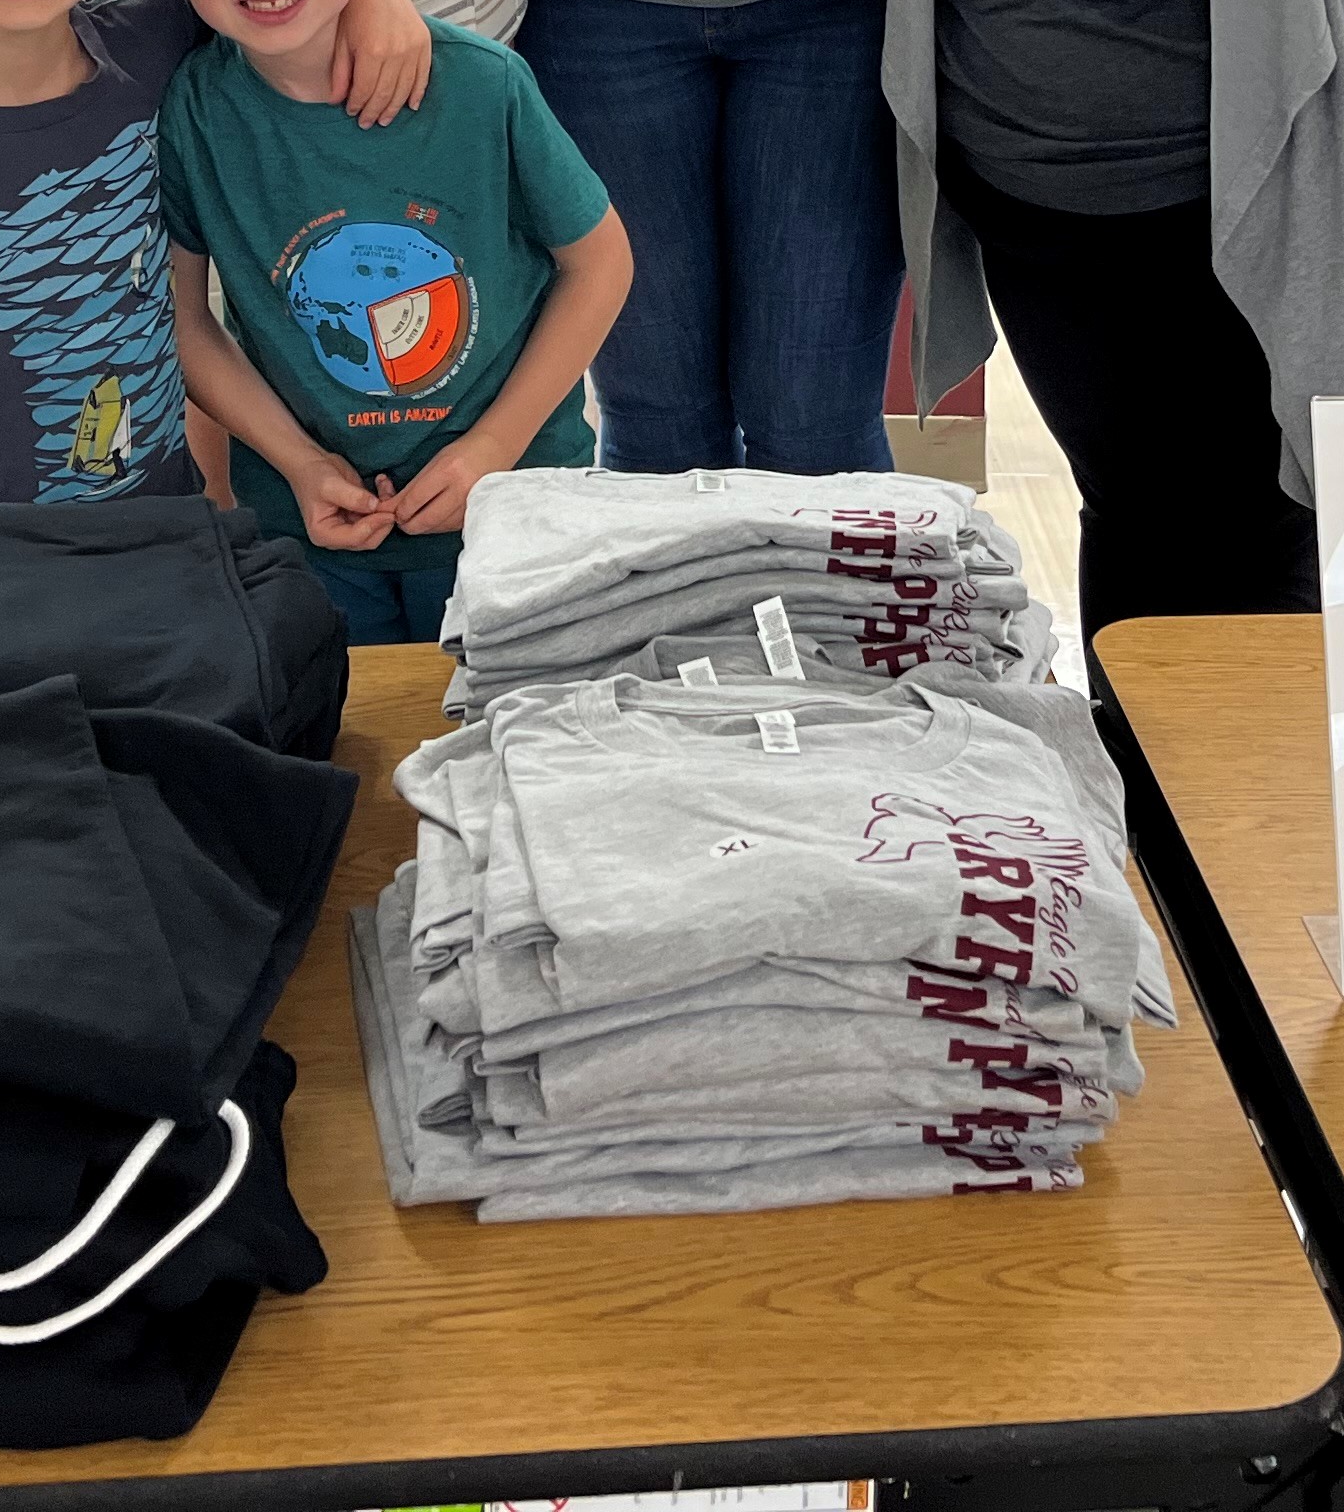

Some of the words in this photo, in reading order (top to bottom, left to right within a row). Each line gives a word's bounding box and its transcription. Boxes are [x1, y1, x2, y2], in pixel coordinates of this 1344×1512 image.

[348, 411, 386, 427] EARTH
[389, 409, 401, 424] IS
[717, 839, 759, 857] XL
[1038, 877, 1083, 959] Eagle
